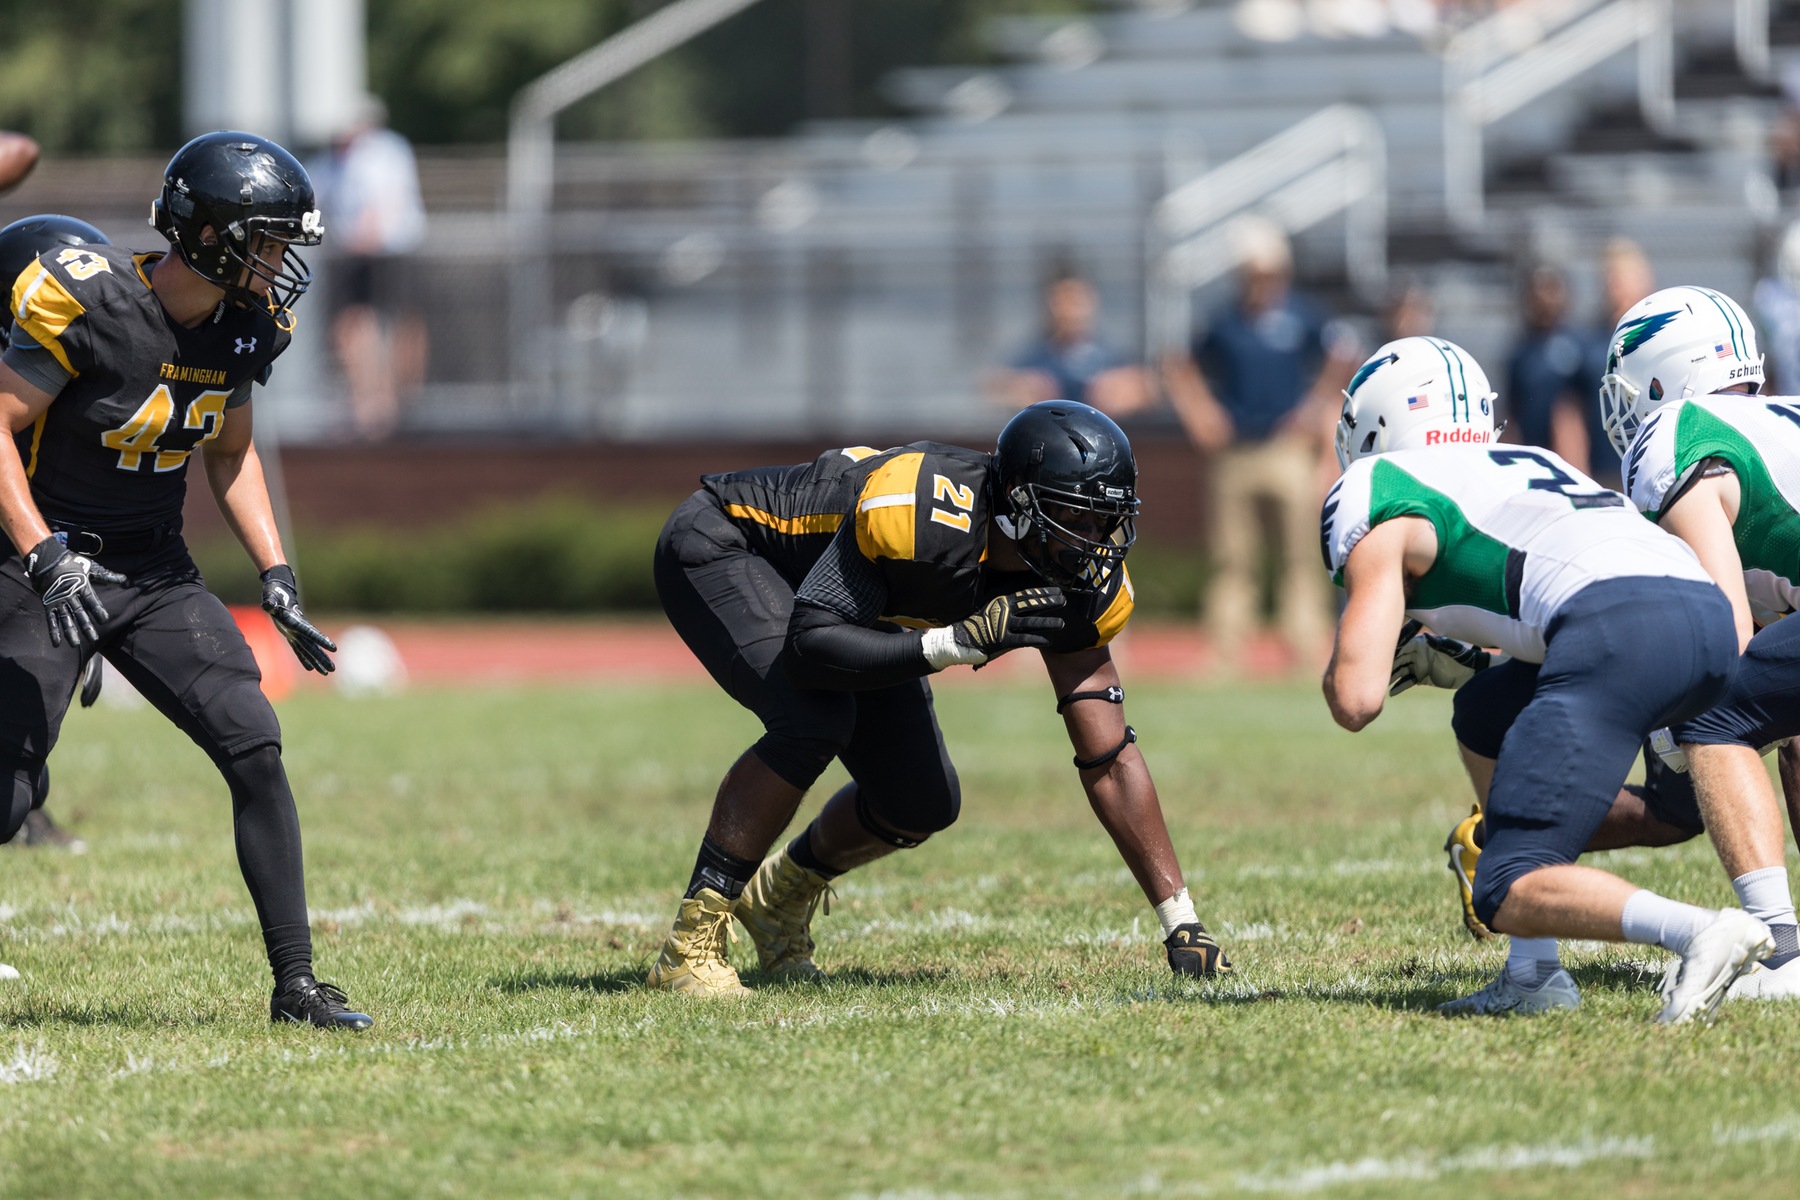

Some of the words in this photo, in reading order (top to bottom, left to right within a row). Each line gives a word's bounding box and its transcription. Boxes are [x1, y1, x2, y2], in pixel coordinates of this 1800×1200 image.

[159, 362, 227, 385] FRAMINGHAM
[1729, 364, 1761, 380] schutt
[1426, 427, 1491, 446] Riddell
[1488, 450, 1625, 510] 2
[930, 473, 975, 534] 21
